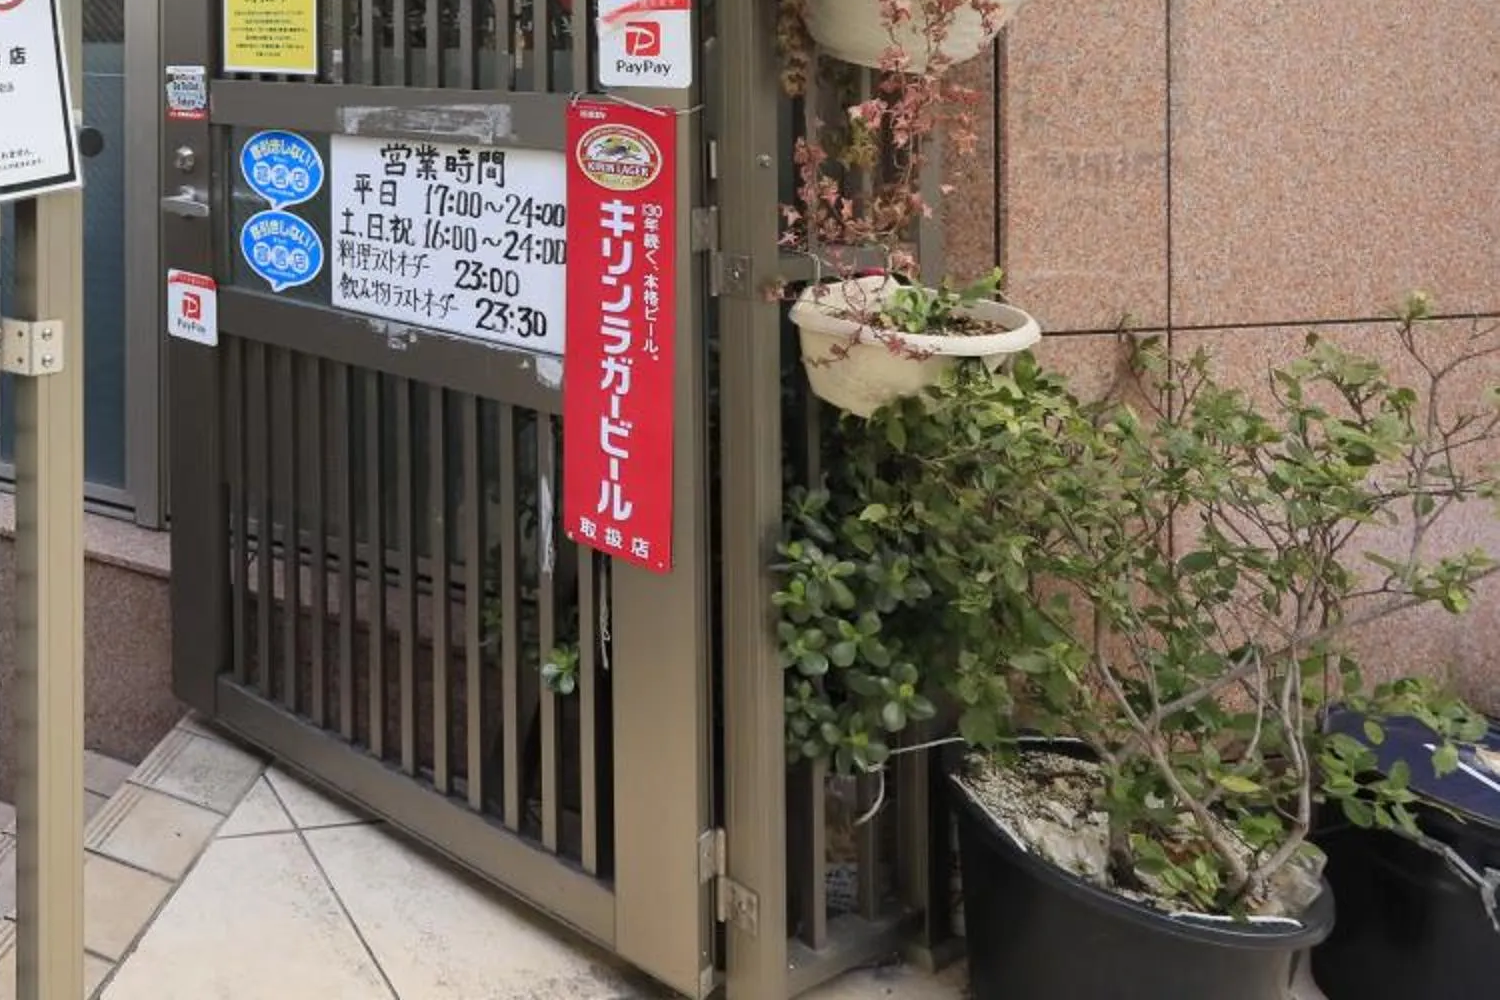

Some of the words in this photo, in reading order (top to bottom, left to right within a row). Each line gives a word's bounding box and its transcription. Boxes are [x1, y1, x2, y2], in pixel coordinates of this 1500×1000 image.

[616, 59, 673, 77] PayPay
[380, 143, 506, 189] 営業時間
[353, 173, 398, 207] 平日
[454, 260, 520, 298] 23:00
[475, 297, 548, 338] 23:30
[597, 199, 636, 522] キリンラガービール
[579, 516, 651, 560] 取扱店
